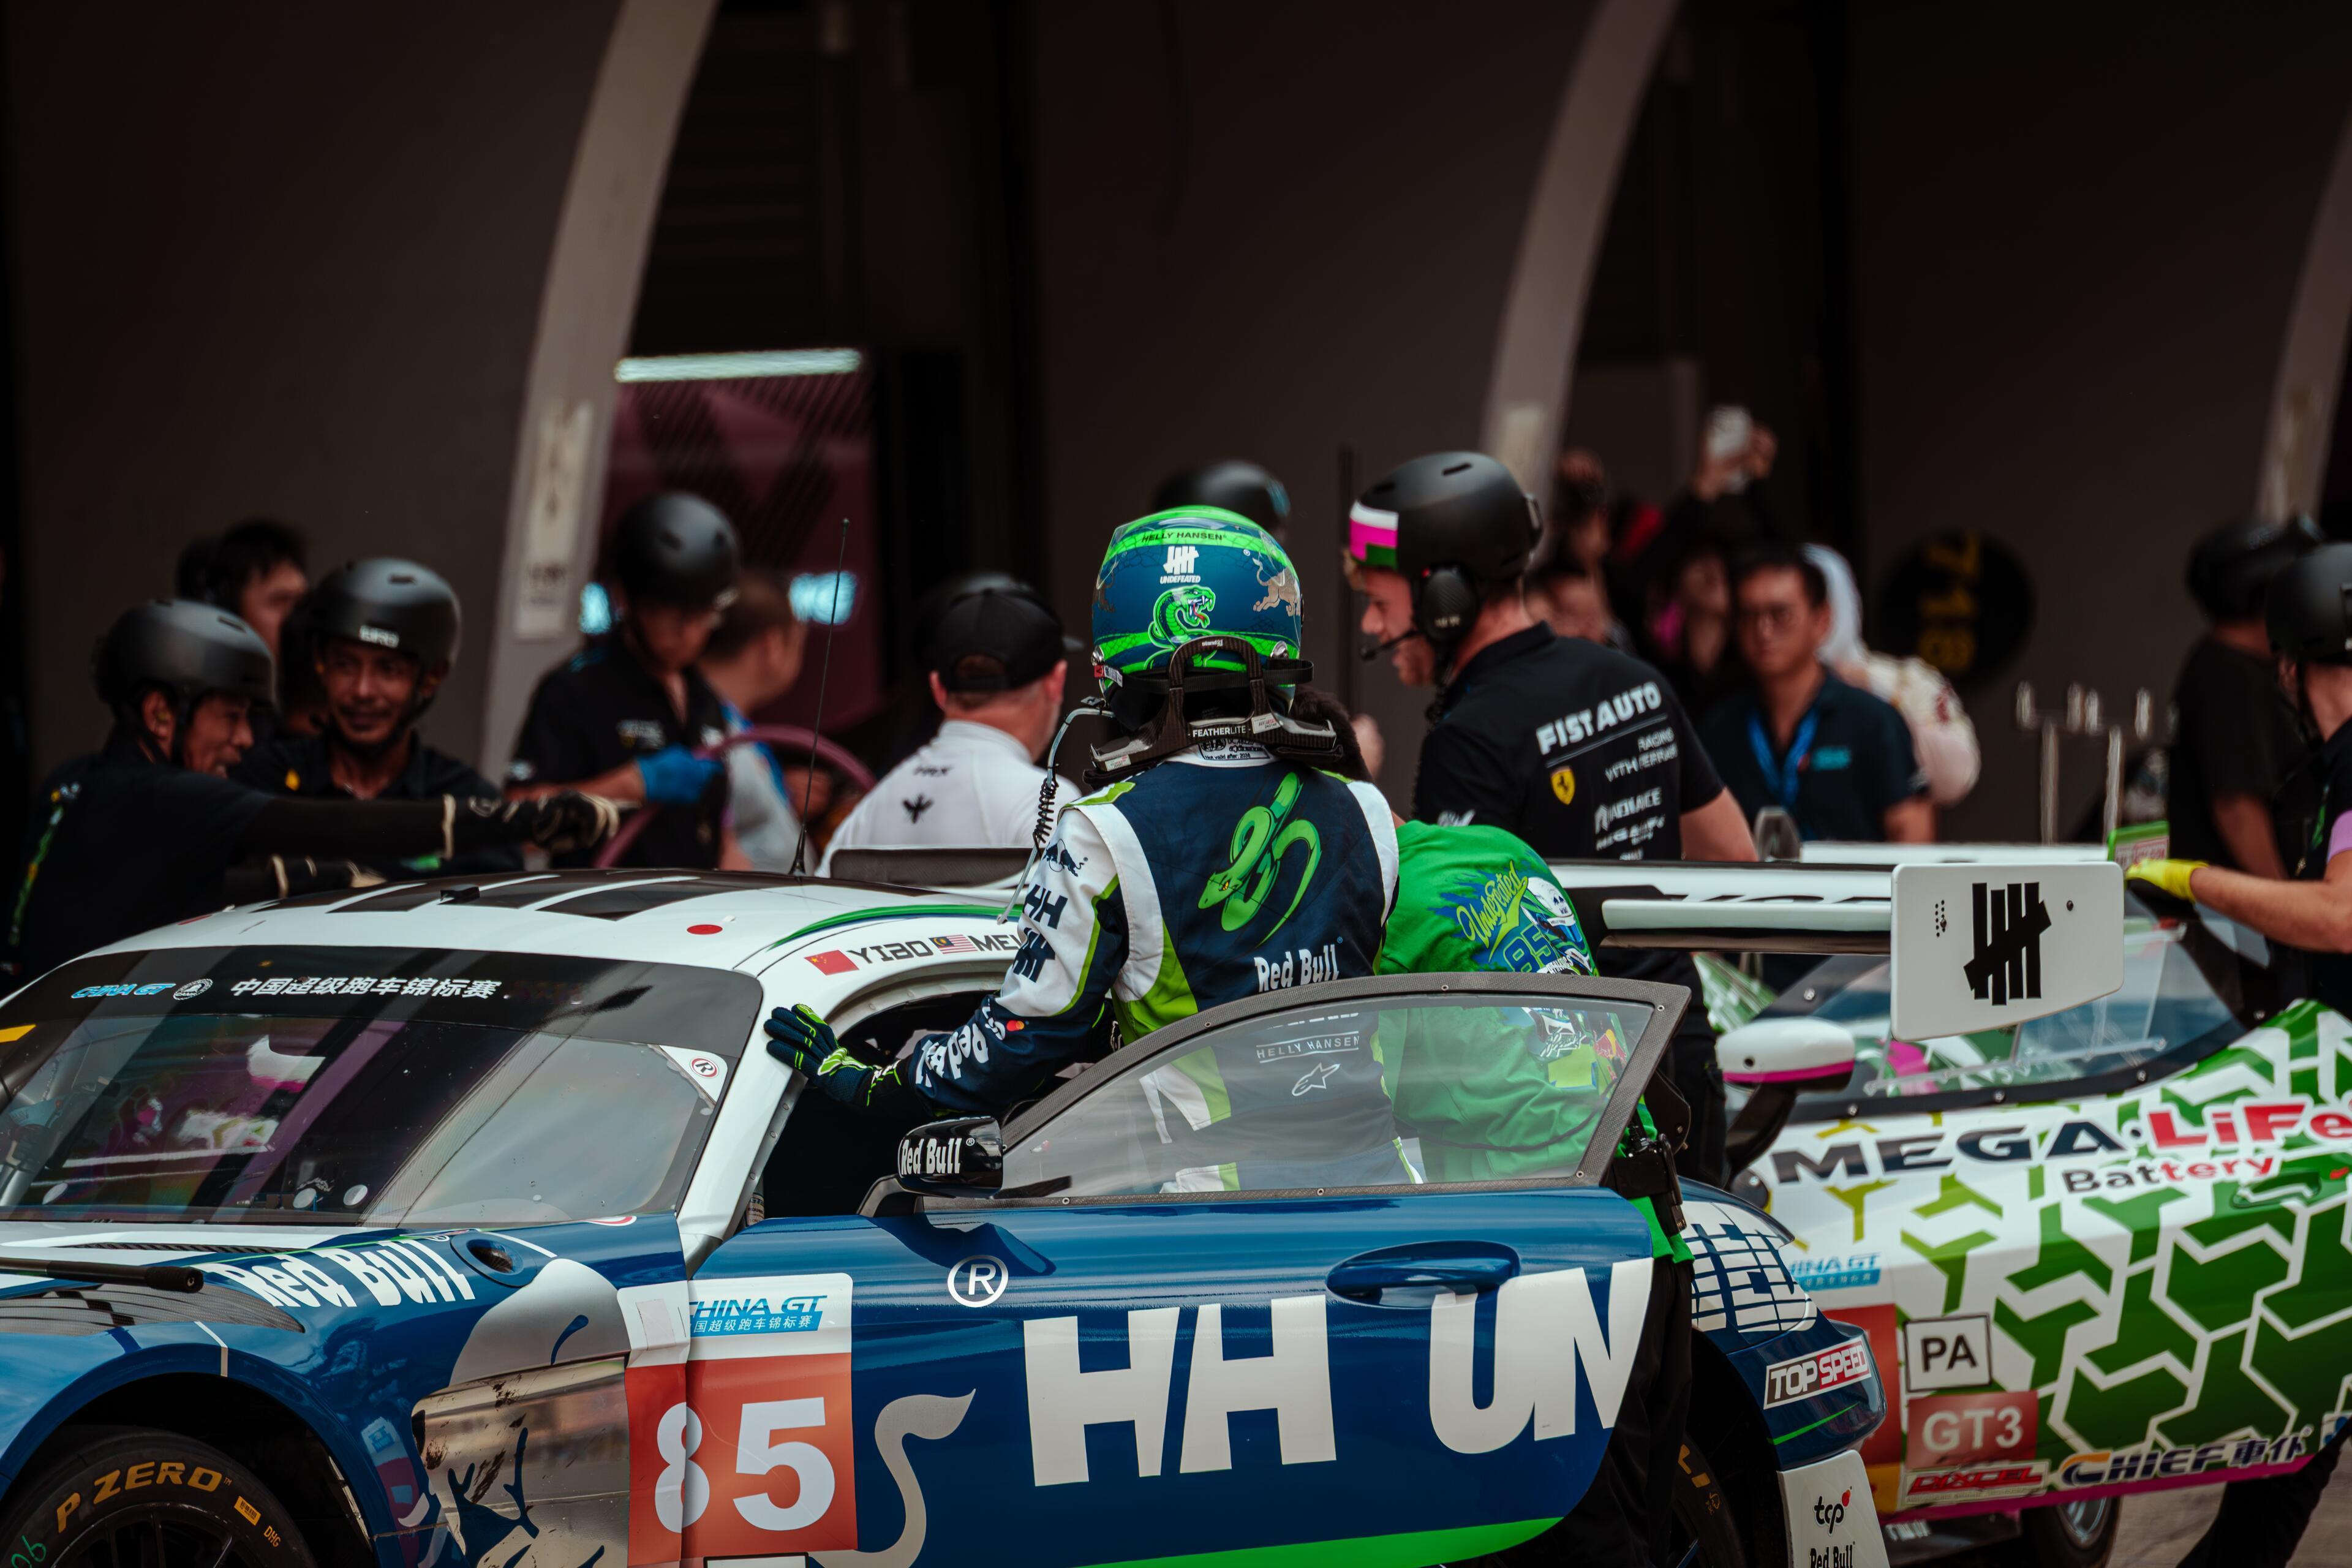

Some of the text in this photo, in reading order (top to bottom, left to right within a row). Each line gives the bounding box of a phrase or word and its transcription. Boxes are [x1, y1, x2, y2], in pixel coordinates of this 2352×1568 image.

[1142, 532, 1223, 543] HELLY HANSEN
[1160, 575, 1200, 584] UNDEFEATED
[1193, 725, 1246, 737] FEATHERLITE
[1536, 682, 1662, 755] FIST AUTO
[1457, 859, 1529, 949] Undefeated
[846, 941, 934, 964] YIBO
[1254, 943, 1340, 992] Red Bull
[230, 978, 502, 999] 中国超级跑车锦标赛
[1256, 1036, 1359, 1059] HELLY HANSEN
[901, 1137, 963, 1175] Red Bull
[1772, 1121, 2127, 1183] MEGA
[2062, 1157, 2273, 1193] Battery
[199, 1238, 476, 1307] Red Bull
[781, 1295, 828, 1313] GT
[690, 1315, 813, 1333] 国超级跑车锦标赛
[1921, 1333, 1977, 1373] PA
[1024, 1294, 1337, 1487] HH
[1771, 1345, 1869, 1400] TOP SPEED
[1922, 1406, 2024, 1452] GT3
[655, 1396, 835, 1533] 85
[1908, 1467, 2043, 1495] DIXCEL
[2061, 1444, 2226, 1486] CHIEF
[56, 1492, 81, 1533] P
[93, 1461, 222, 1504] ZERO
[1814, 1496, 1844, 1534] tcp
[263, 1525, 281, 1547] DHG
[1810, 1545, 1853, 1568] Red Bull
